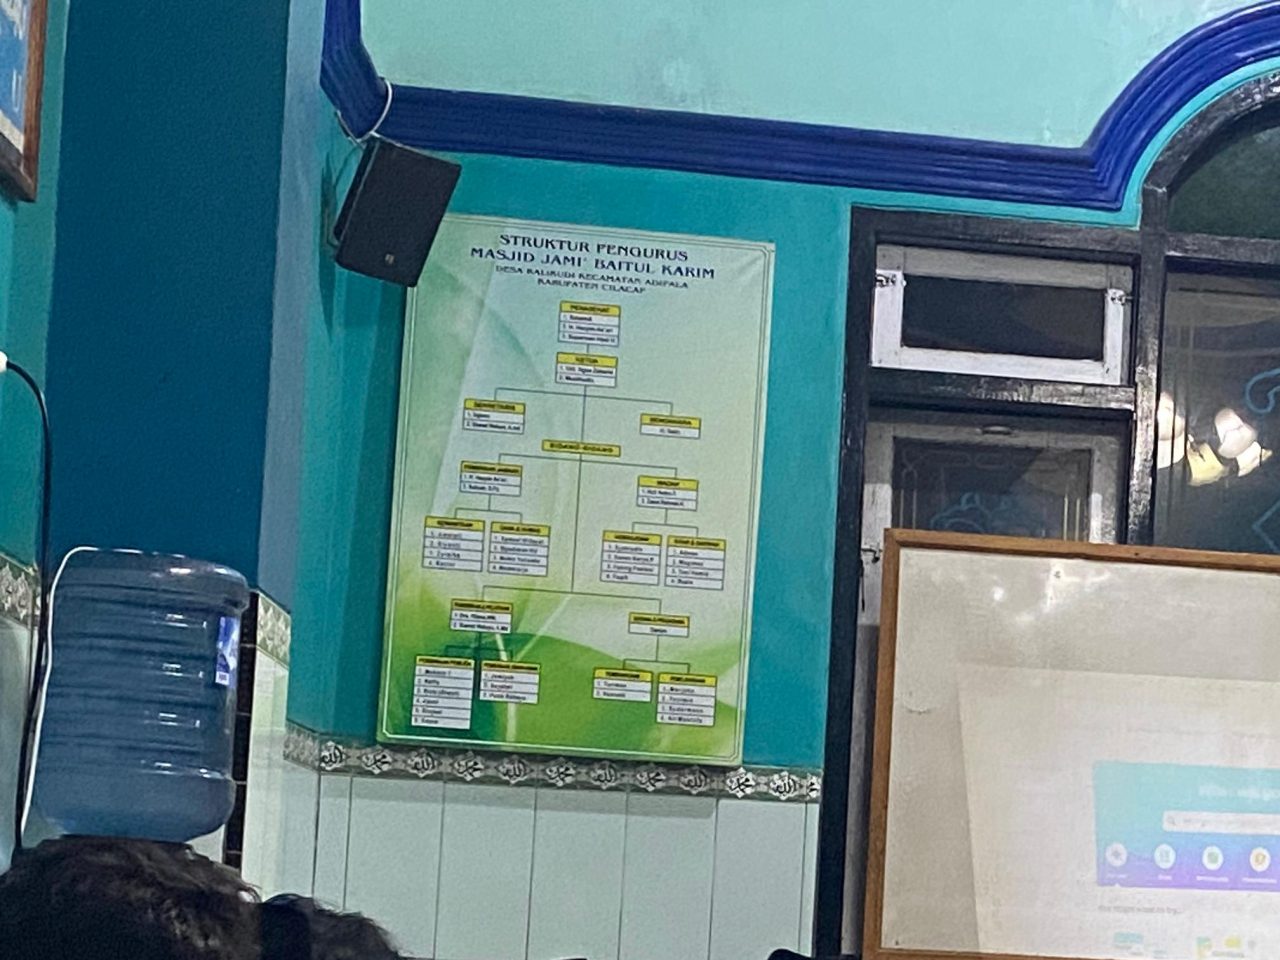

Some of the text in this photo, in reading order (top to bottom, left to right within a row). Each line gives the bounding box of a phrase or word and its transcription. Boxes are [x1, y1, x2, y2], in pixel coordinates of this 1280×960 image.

[499, 234, 688, 261] STRUKTUR PENGURUS
[470, 247, 535, 263] MASJID
[594, 258, 655, 274] BAITUL
[661, 264, 715, 280] KARIM
[495, 265, 523, 274] DESA
[578, 272, 642, 284] KECAMATAN
[537, 278, 599, 290] KABUPATEN
